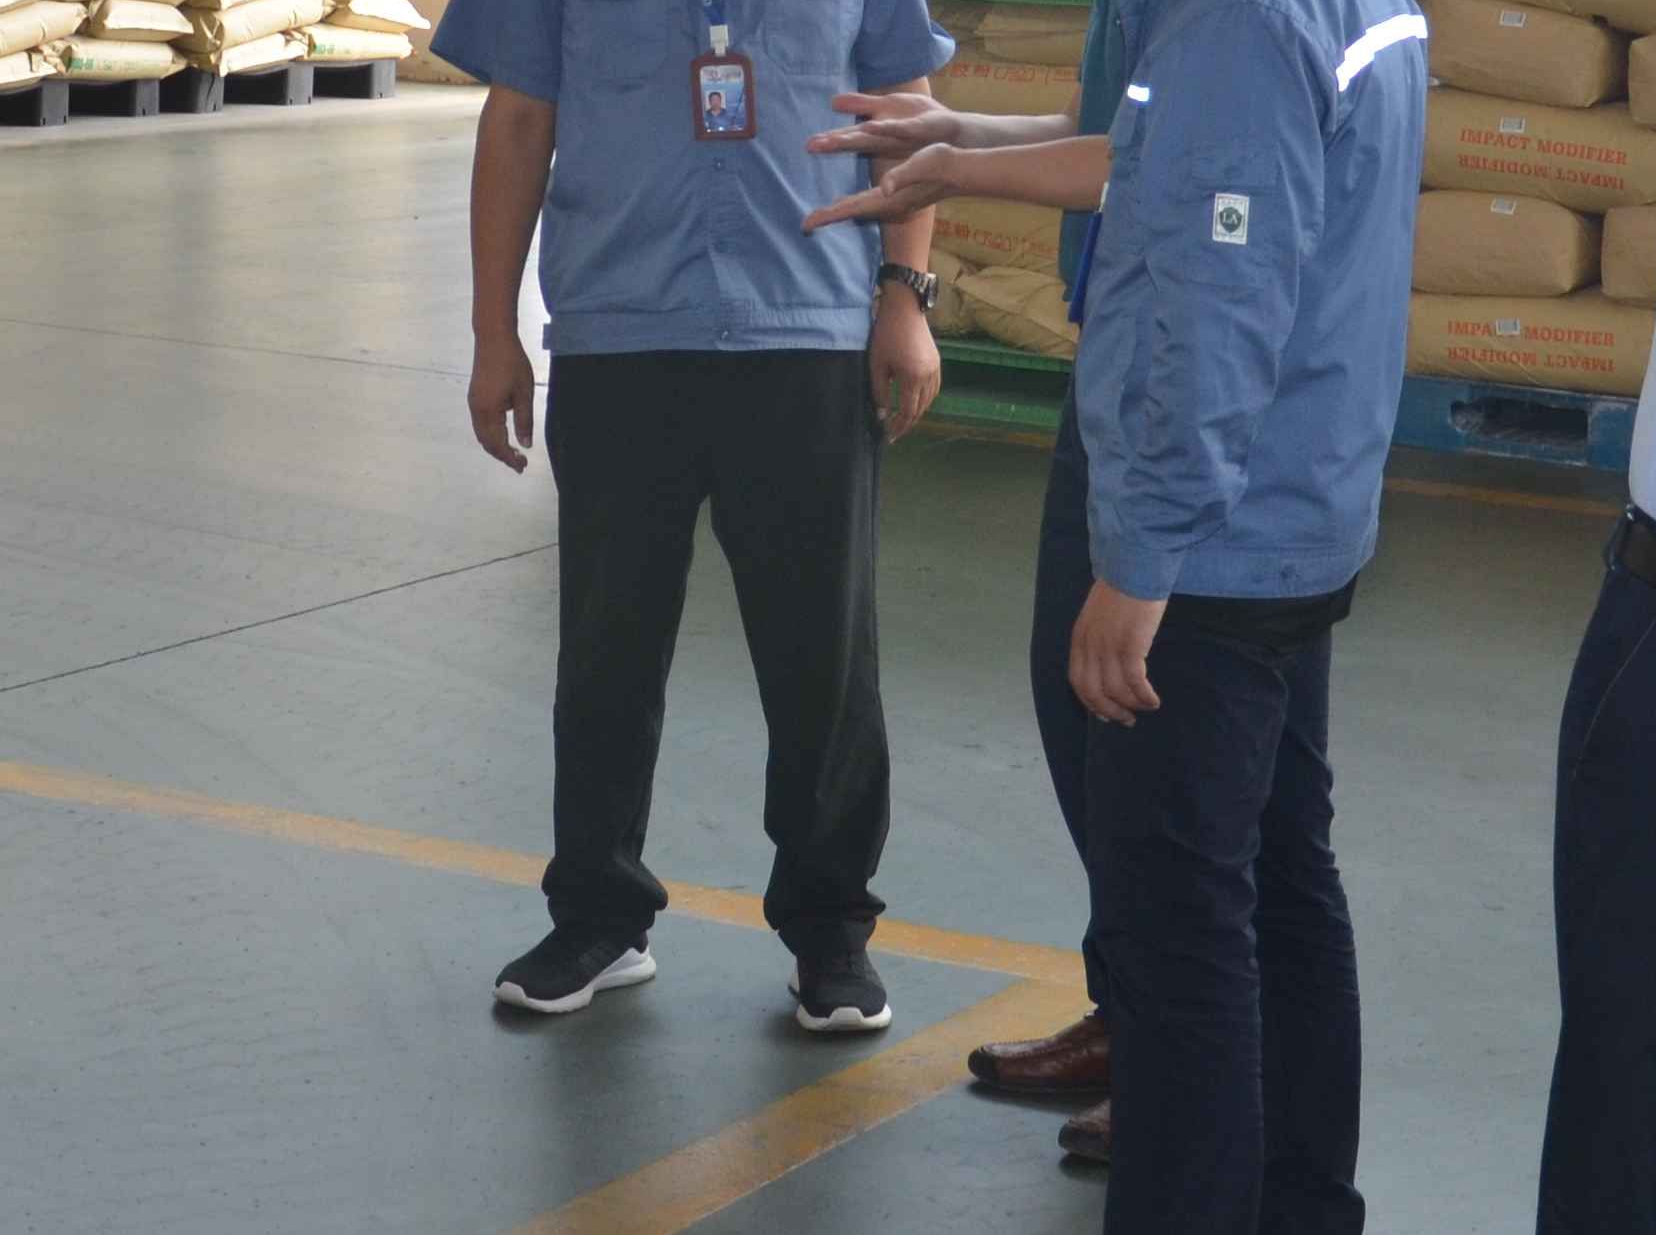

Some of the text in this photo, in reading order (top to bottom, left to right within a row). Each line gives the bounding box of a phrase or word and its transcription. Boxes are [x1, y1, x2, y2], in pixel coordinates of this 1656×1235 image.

[1460, 128, 1627, 165] IMPACT MODIFIER
[1457, 154, 1624, 190] IMPACT MODIFIER
[1524, 326, 1615, 347] MODIFIER
[1447, 347, 1616, 372] IMPACT MODIFIER
